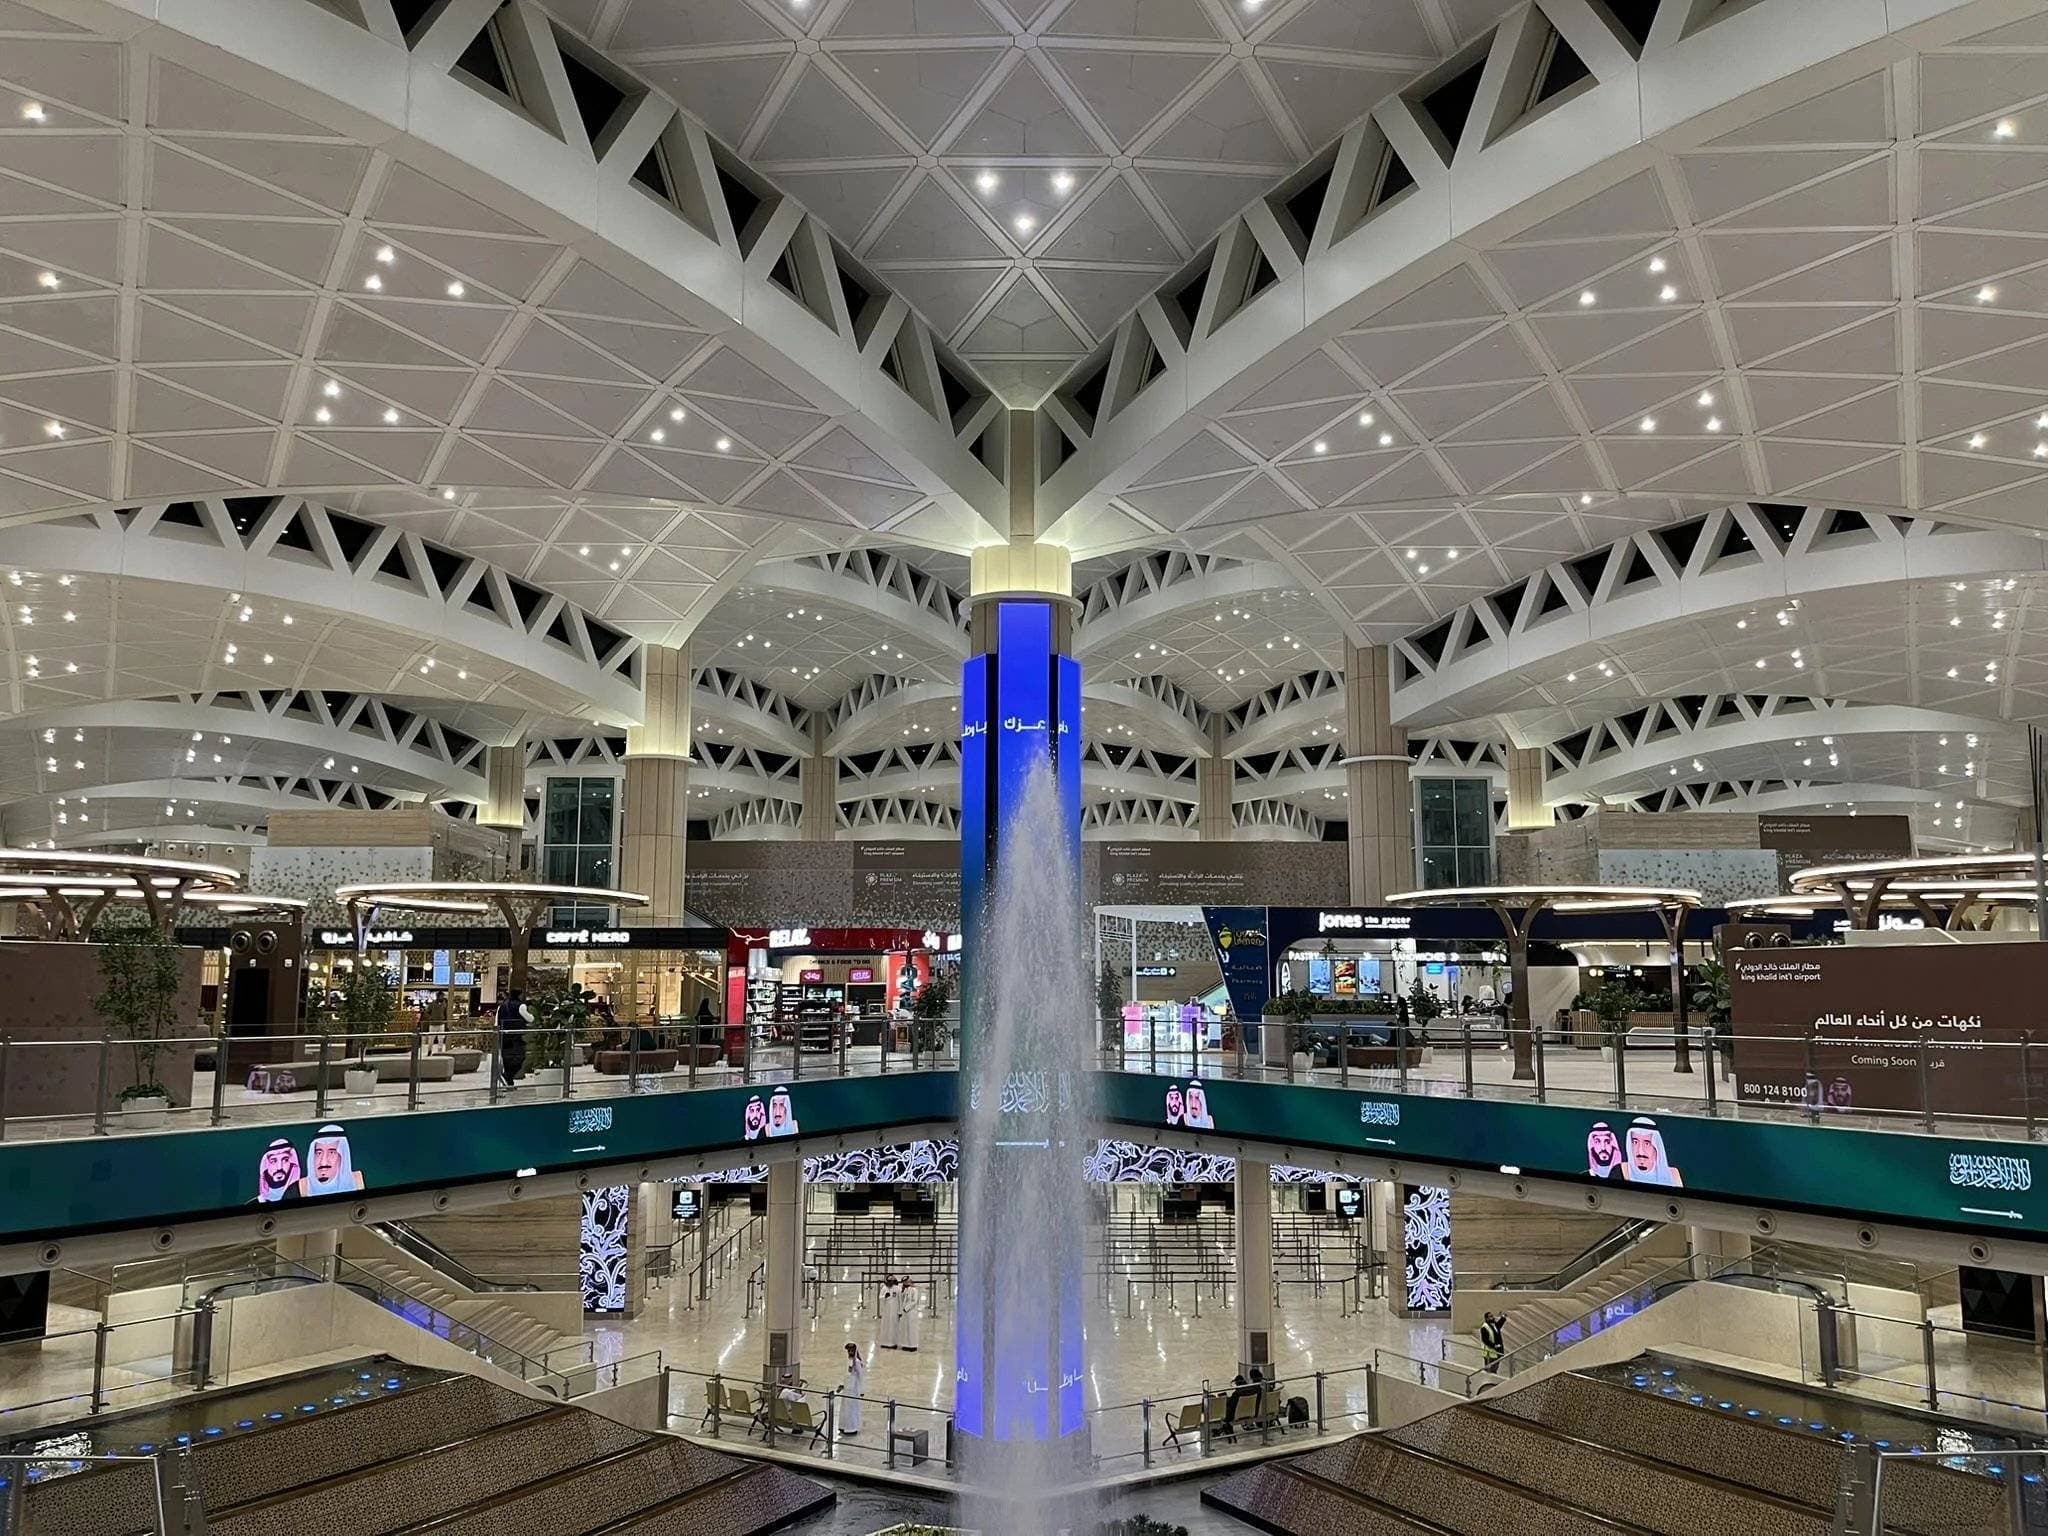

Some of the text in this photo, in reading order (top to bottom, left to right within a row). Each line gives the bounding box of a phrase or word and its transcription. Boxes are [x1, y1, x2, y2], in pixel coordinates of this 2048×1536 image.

[1003, 716, 1046, 733] عزك
[1318, 911, 1363, 932] jones
[1364, 916, 1379, 924] the
[1381, 917, 1412, 926] grocer
[591, 932, 630, 943] NERO
[769, 928, 808, 948] RELAY
[1740, 963, 1821, 974] مطار الملك خالد الدولي
[1741, 974, 1756, 983] king
[1757, 973, 1778, 981] khalid
[1794, 973, 1821, 982] airport
[1814, 1010, 1982, 1032] نكهات من كل أنحاء العالم
[1851, 1055, 1918, 1068] Coming Soon
[1743, 1083, 1808, 1098] 800 124 8100
